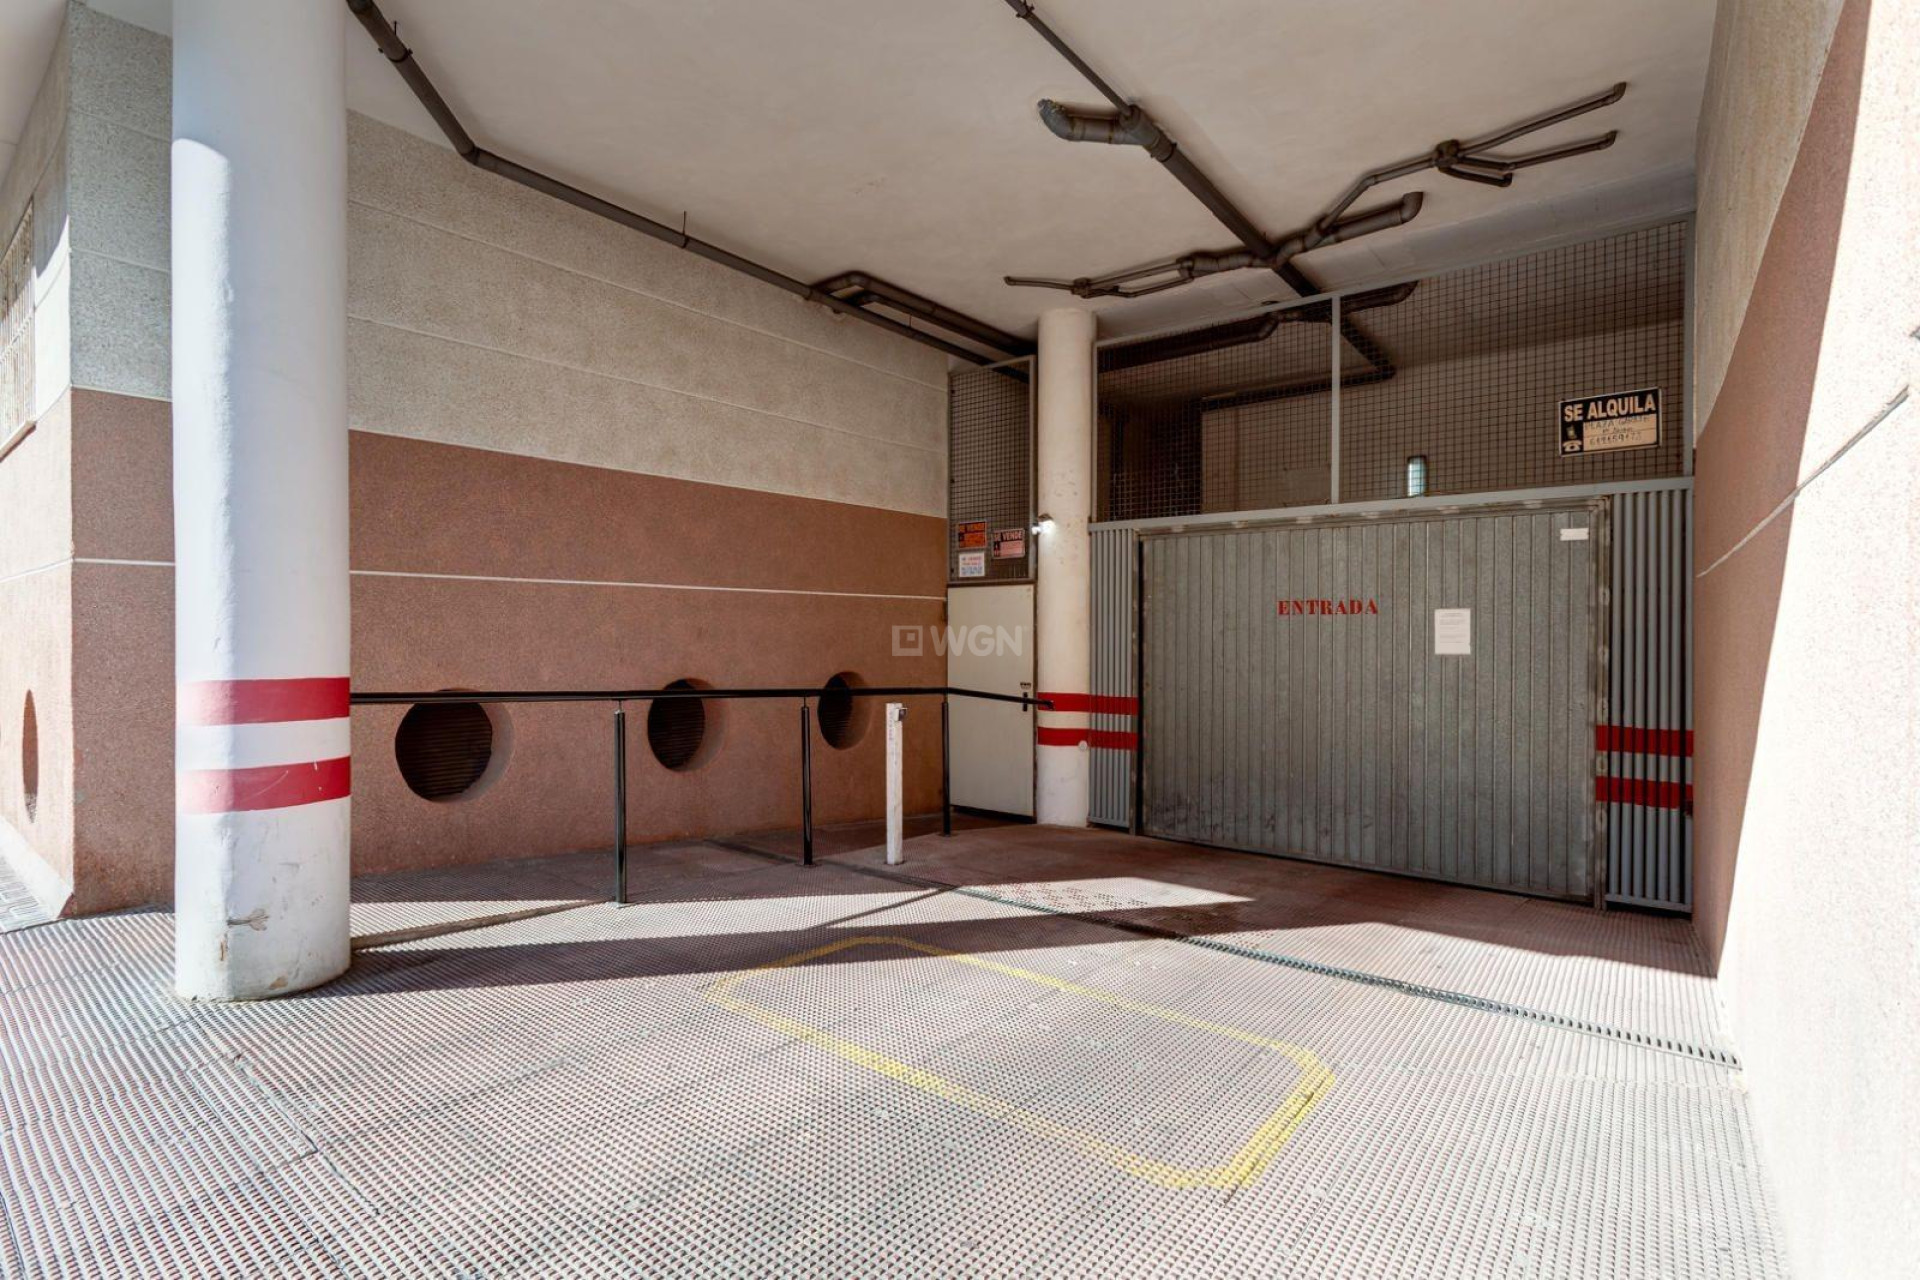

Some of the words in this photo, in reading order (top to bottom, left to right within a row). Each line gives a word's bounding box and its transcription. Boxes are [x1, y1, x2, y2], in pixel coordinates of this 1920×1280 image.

[1564, 404, 1583, 422] SE
[1587, 394, 1656, 419] ALQUILA
[1003, 530, 1022, 541] VENDE
[1277, 598, 1378, 615] ENTRADA
